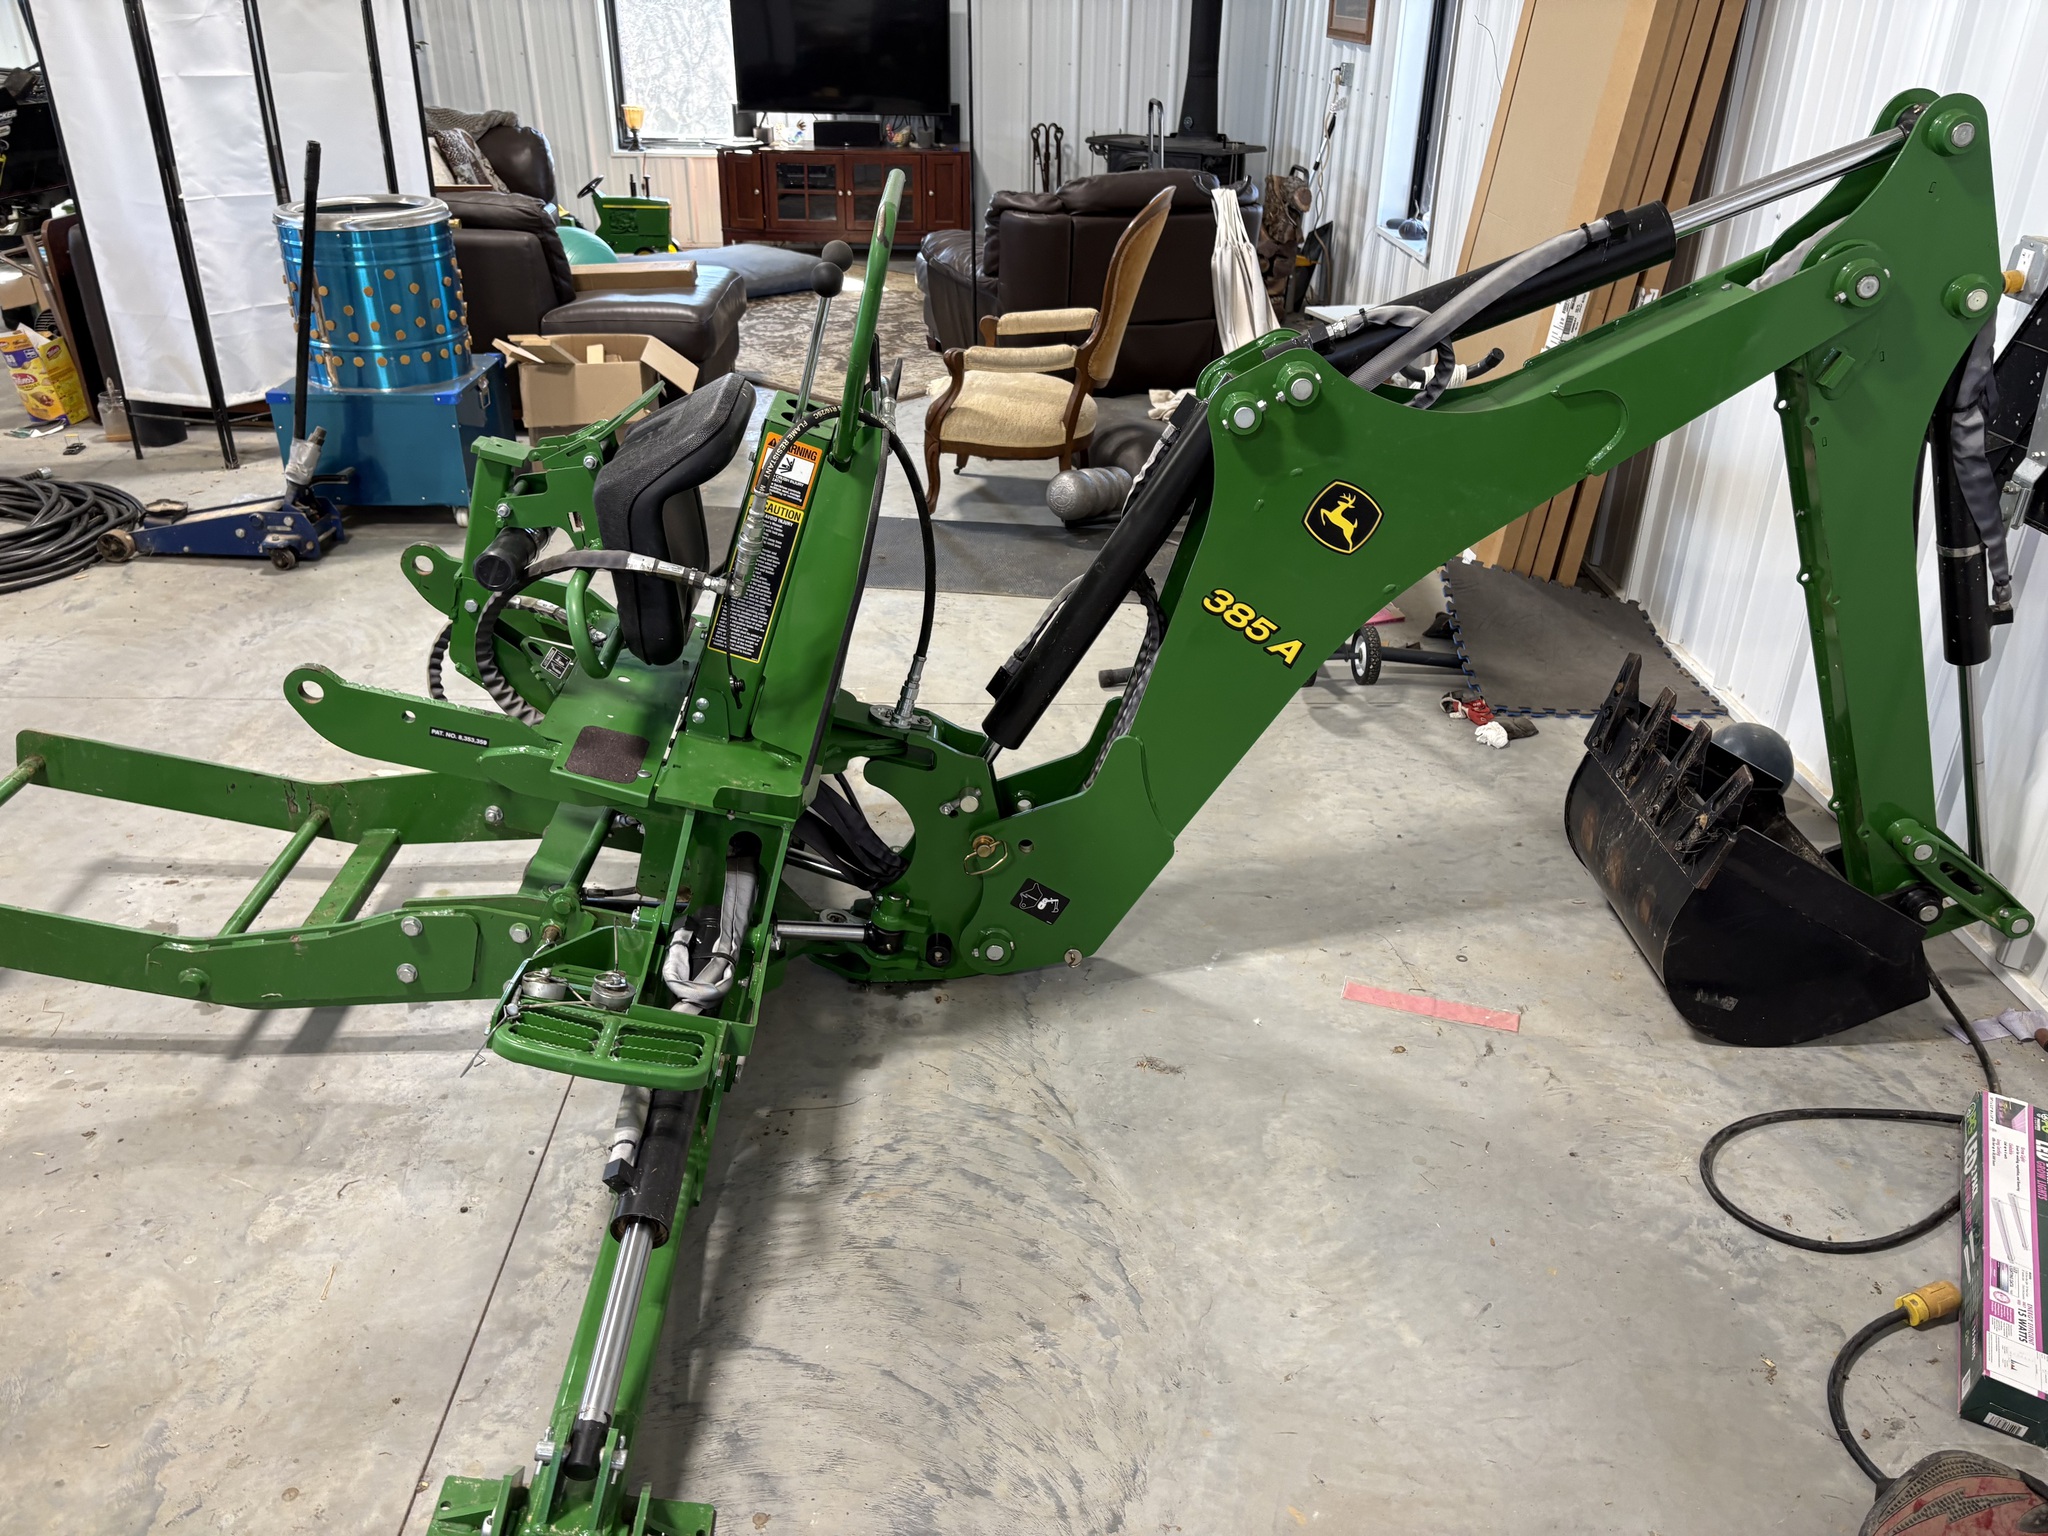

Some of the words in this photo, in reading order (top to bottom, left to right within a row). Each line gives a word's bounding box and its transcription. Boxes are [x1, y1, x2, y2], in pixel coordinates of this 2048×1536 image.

[786, 420, 808, 441] FLAME
[764, 439, 790, 479] RESISTANT
[431, 728, 444, 737] PAT.
[446, 732, 457, 740] NO.
[1964, 1131, 1978, 1176] LED
[1971, 1171, 1979, 1201] PACK
[2036, 1161, 2047, 1181] GROW
[2037, 1179, 2047, 1201] LIGHTS
[2018, 1307, 2027, 1318] 15
[2018, 1318, 2028, 1343] WATTS
[2027, 1321, 2035, 1346] EFFICIENT
